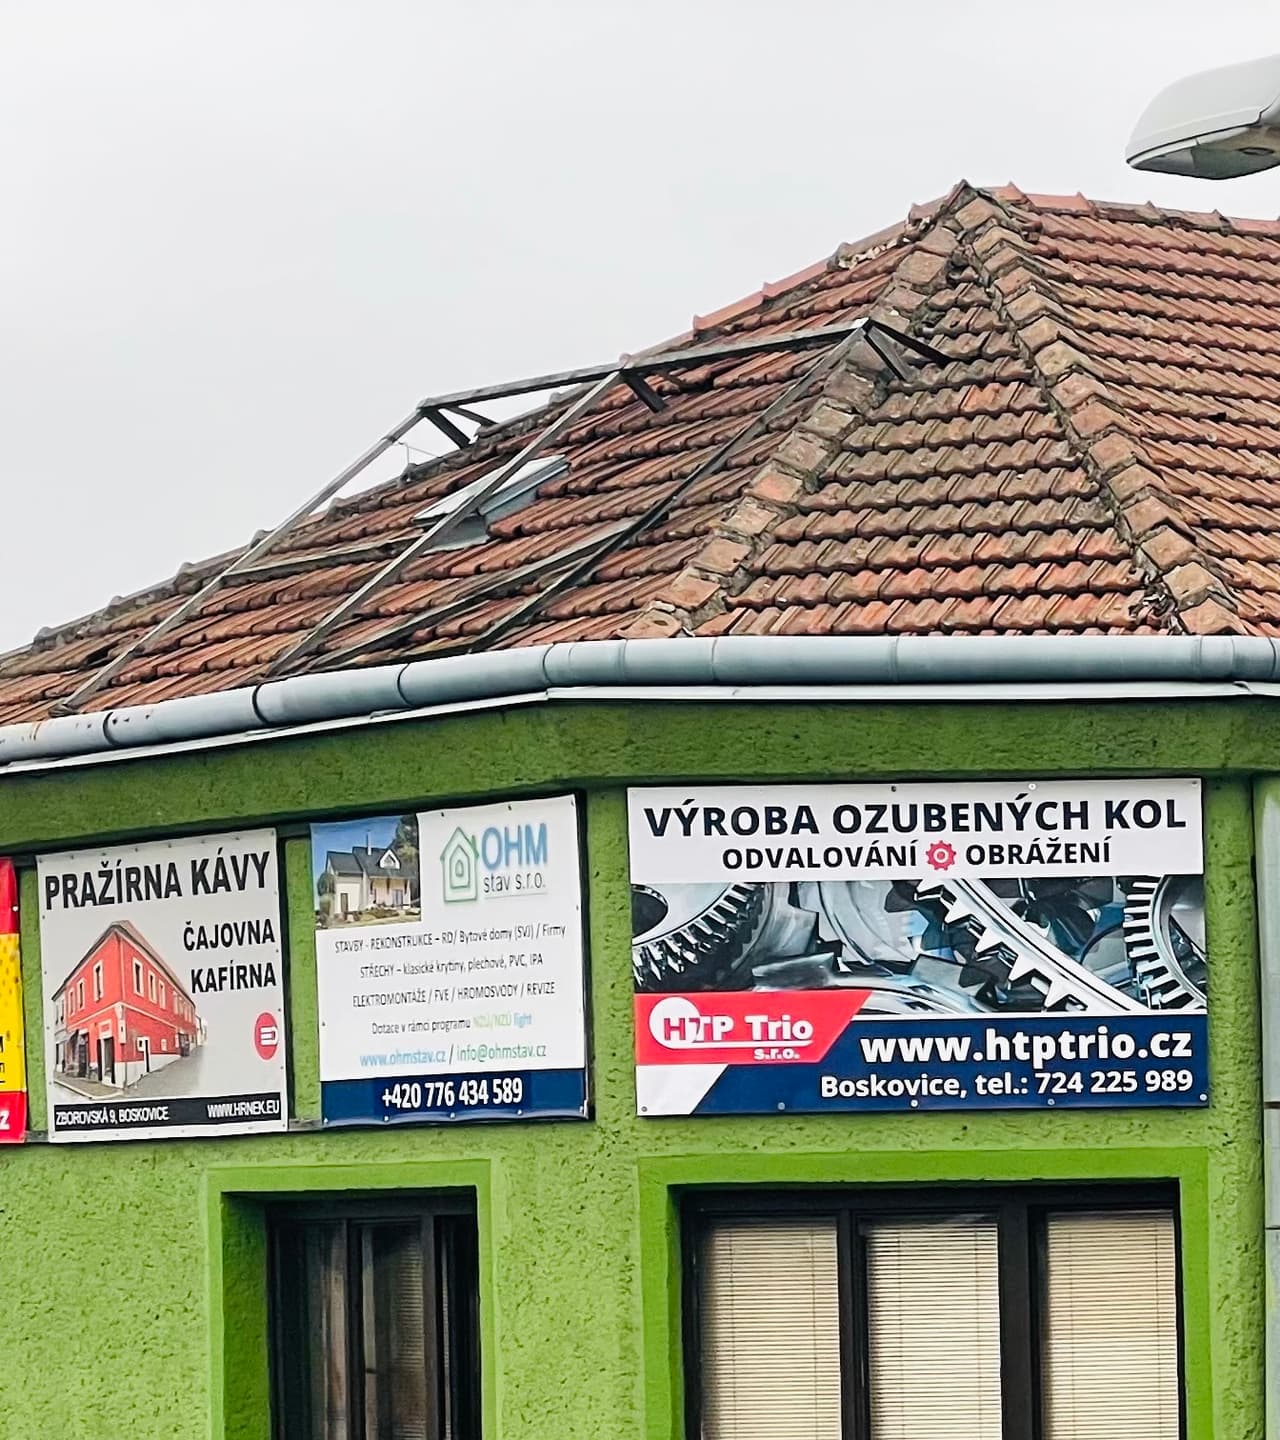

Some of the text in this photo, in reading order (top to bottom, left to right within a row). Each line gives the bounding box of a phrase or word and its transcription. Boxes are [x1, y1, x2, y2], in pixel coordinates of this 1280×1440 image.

[644, 793, 1187, 837] VÝROBA OZUBENÝCH KOL
[481, 822, 548, 871] OHM
[722, 835, 1112, 869] ODVALOVÁNÍ OBRÁŽENÍ
[45, 847, 270, 910] PRAŽÍRNA KÁVY
[483, 872, 547, 893] stav s.r.o.
[183, 919, 276, 951] ČAJOVNA
[191, 960, 277, 994] KAFÍRNA
[664, 1014, 814, 1041] HTP Trio
[457, 1043, 547, 1063] info@ohmstav.cz
[754, 1047, 800, 1060] s.r.o.
[860, 1025, 1193, 1069] www.htptrio.cz
[382, 1077, 523, 1108] +420 776 434 589
[820, 1069, 1193, 1098] Boskovice, tel.: 724 225 989
[55, 1107, 109, 1126] ZBOROVSKÁ
[118, 1106, 169, 1123] BOSKOVICE
[207, 1100, 280, 1119] WWW.HRNEK.EU
